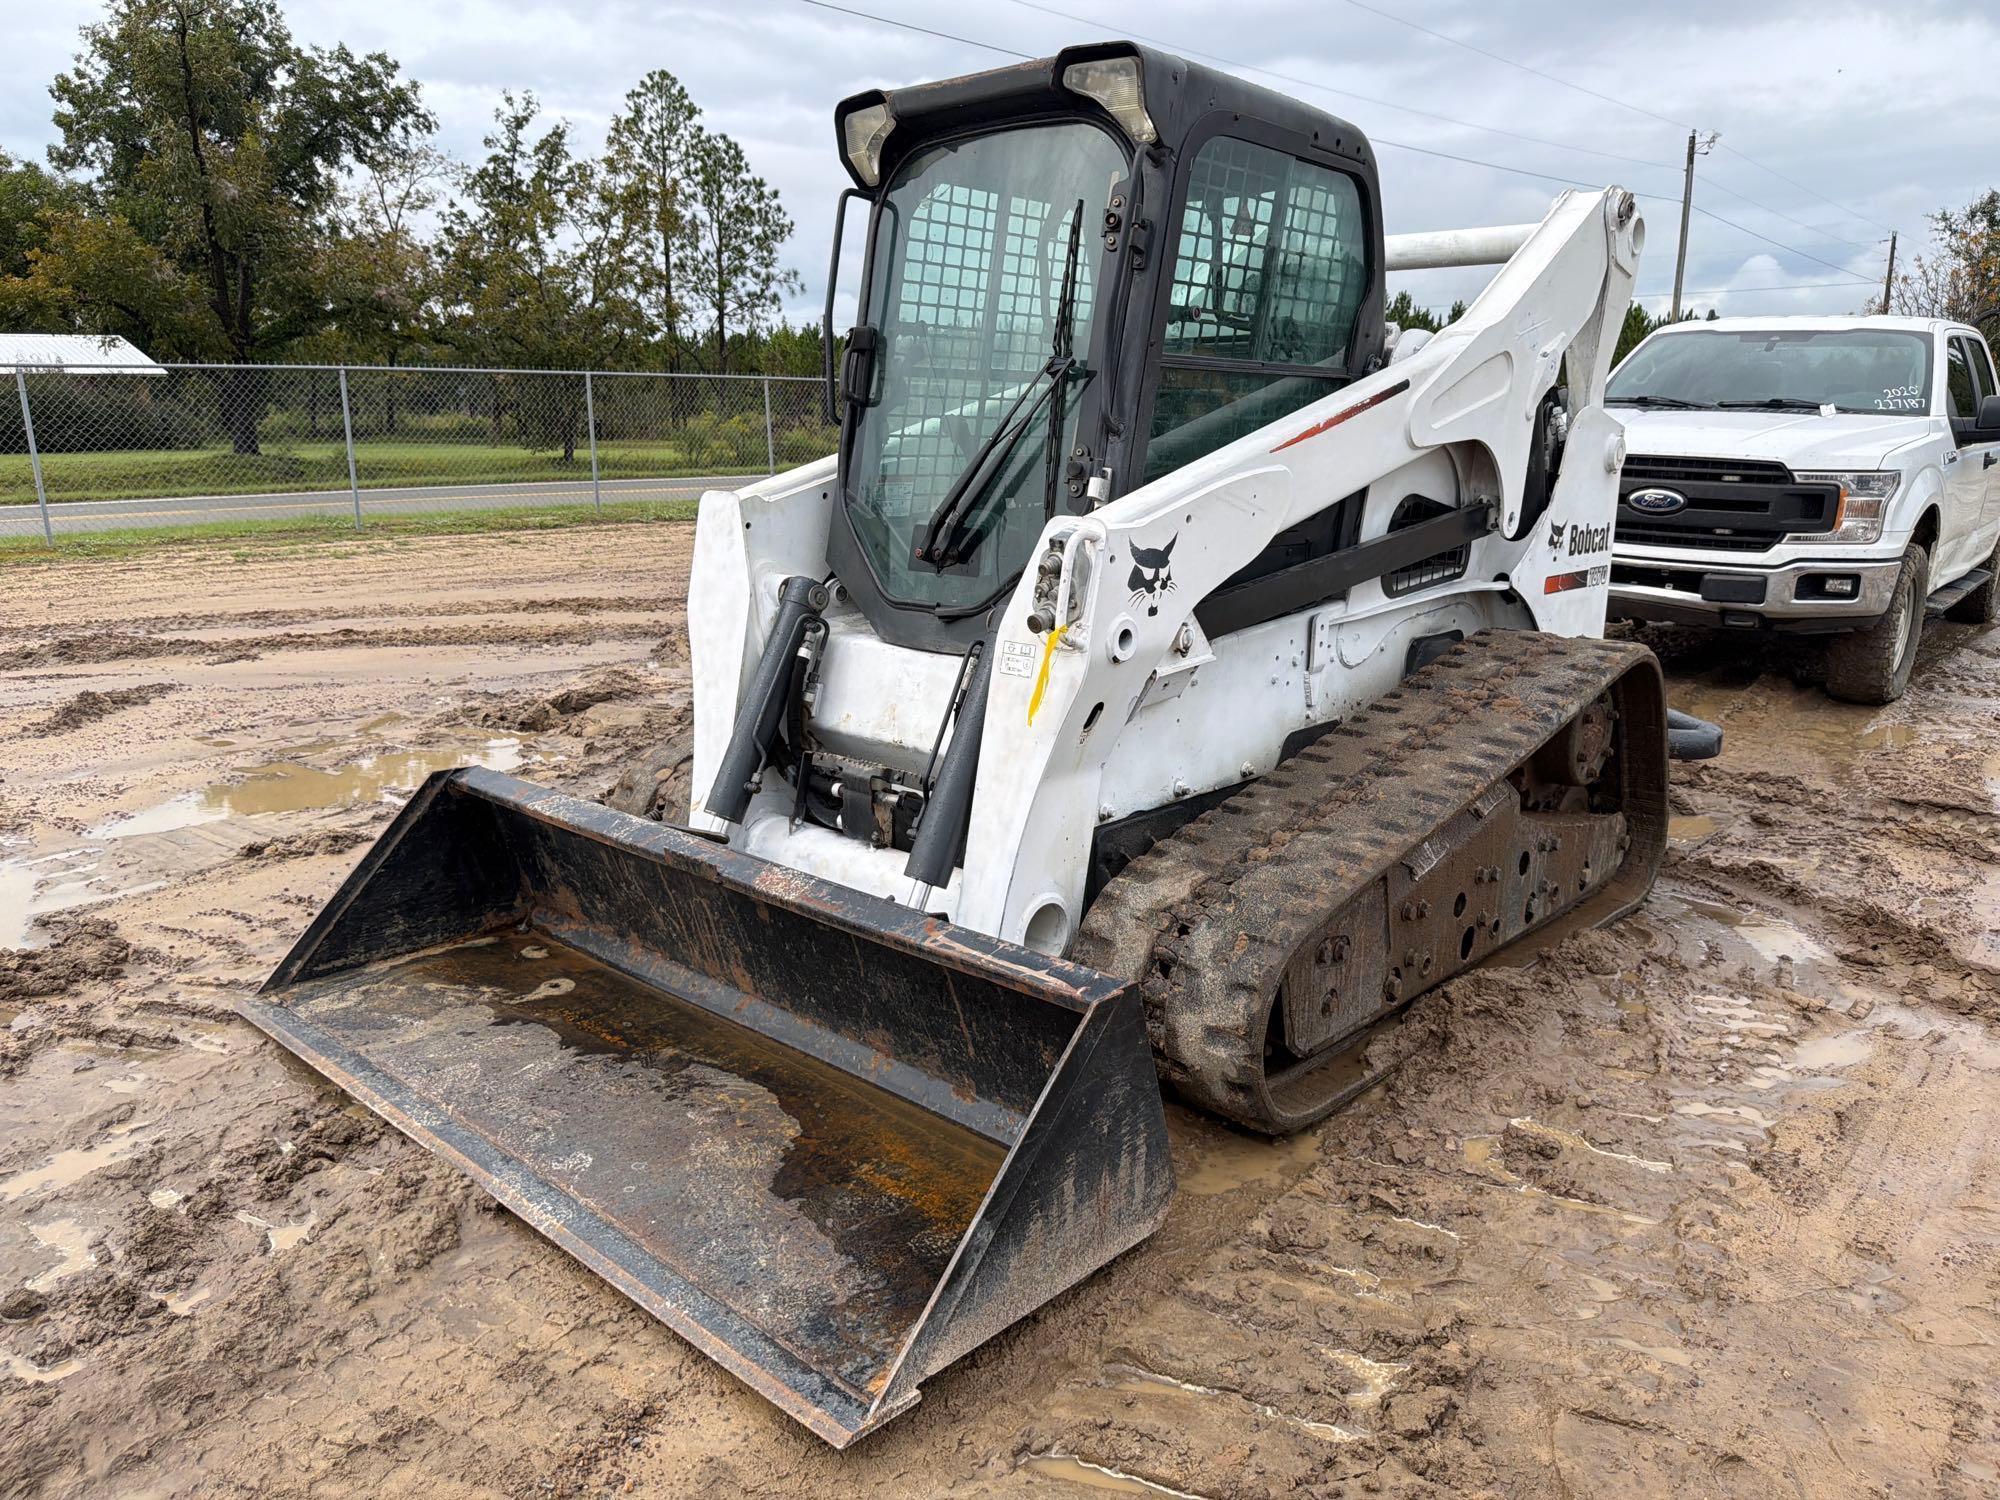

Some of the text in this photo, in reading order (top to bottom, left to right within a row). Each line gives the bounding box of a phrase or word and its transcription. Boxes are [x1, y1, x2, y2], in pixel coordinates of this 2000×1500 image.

[1883, 385, 1918, 399] 2020
[1874, 398, 1925, 410] 227187
[1640, 493, 1671, 508] Ford
[1568, 521, 1611, 557] Bobcat
